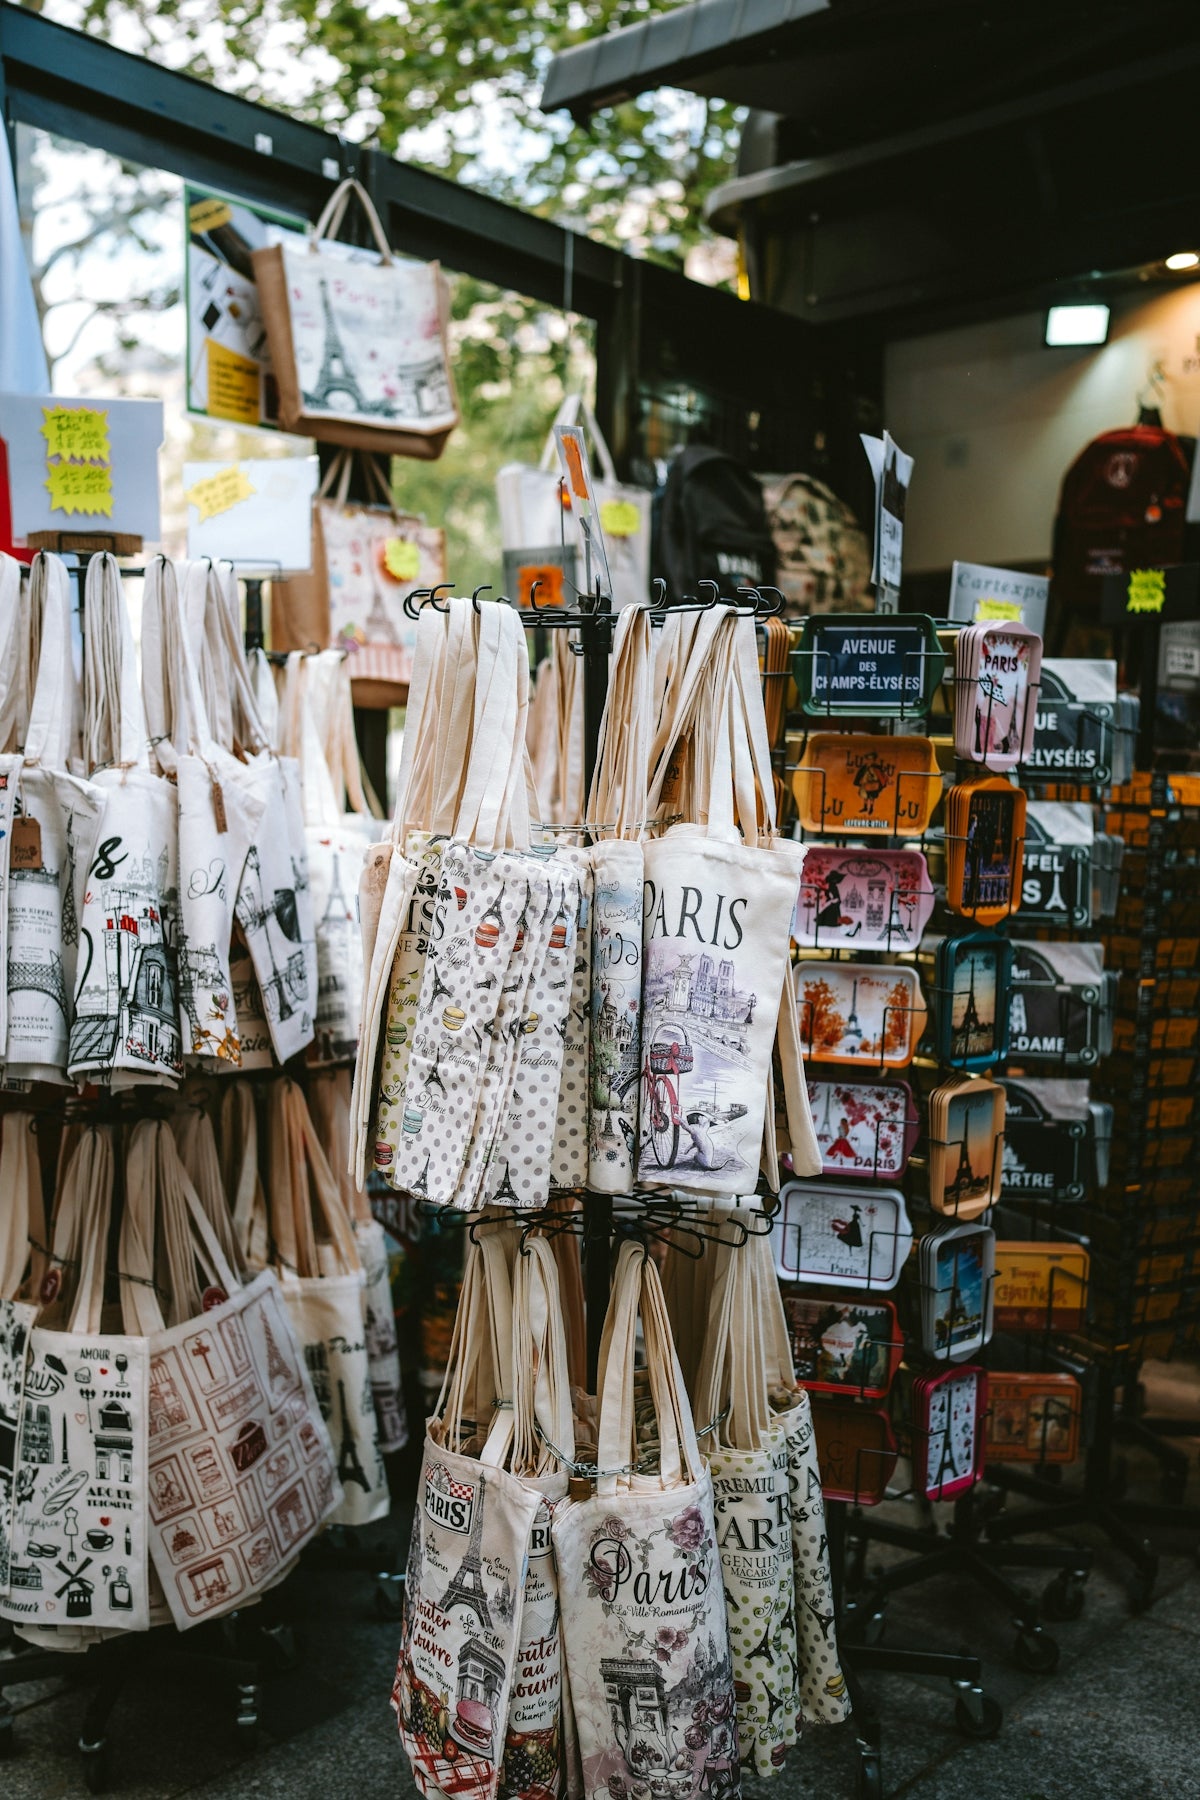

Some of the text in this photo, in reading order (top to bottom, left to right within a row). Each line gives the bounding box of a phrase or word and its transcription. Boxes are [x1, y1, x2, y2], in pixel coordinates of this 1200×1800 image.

[841, 639, 896, 655] AVENUE
[859, 661, 877, 672] DES
[984, 654, 1019, 674] PARIS
[643, 880, 748, 950] PARIS
[859, 977, 889, 989] Paris
[854, 1156, 896, 1169] PARIS
[831, 1263, 859, 1275] Paris
[80, 1348, 110, 1360] AMOUR
[86, 1486, 115, 1497] ARC
[87, 1499, 133, 1511] TRIOMPHE
[425, 1484, 466, 1528] PARIS
[590, 1538, 709, 1605] Paris
[740, 1578, 776, 1589] est. 1935
[615, 1600, 705, 1618] La Ville Romantique
[421, 1620, 436, 1638] au
[463, 1622, 481, 1639] Tour
[522, 1663, 548, 1678] au
